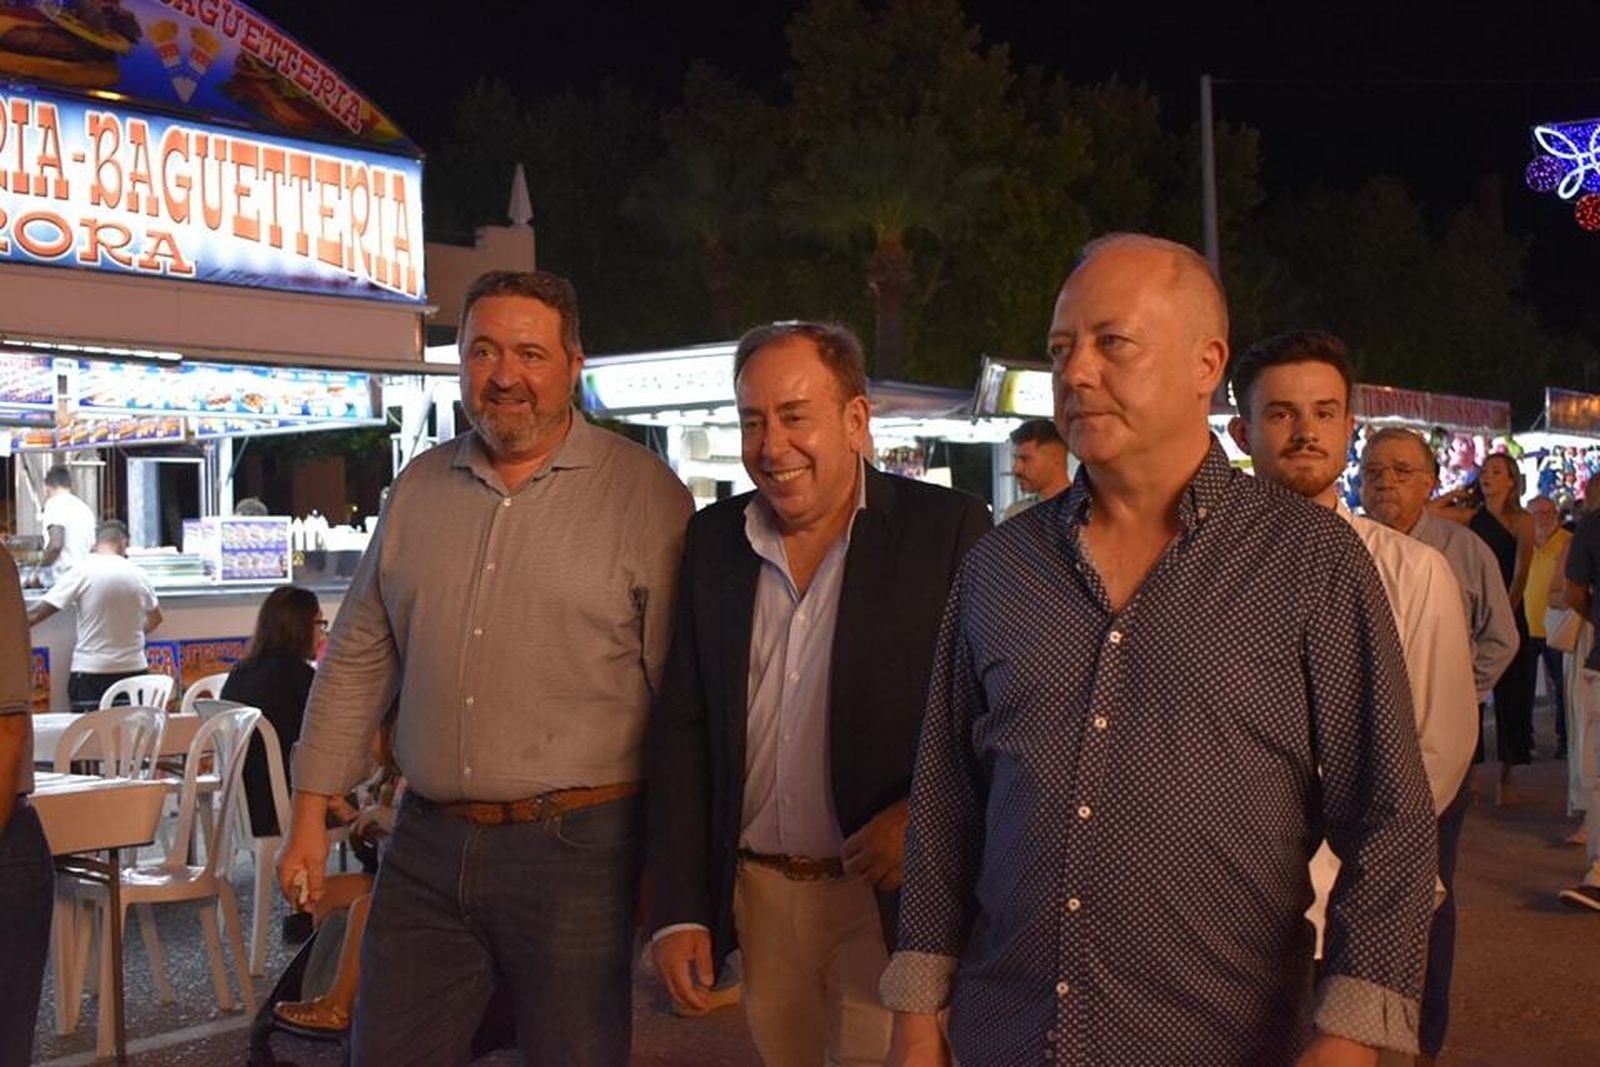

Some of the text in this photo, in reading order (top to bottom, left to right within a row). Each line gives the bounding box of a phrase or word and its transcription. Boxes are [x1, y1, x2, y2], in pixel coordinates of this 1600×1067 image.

[161, 0, 361, 131] GUETTERIA
[0, 98, 417, 295] IA-BAGUETTERIA
[0, 207, 192, 274] ORA
